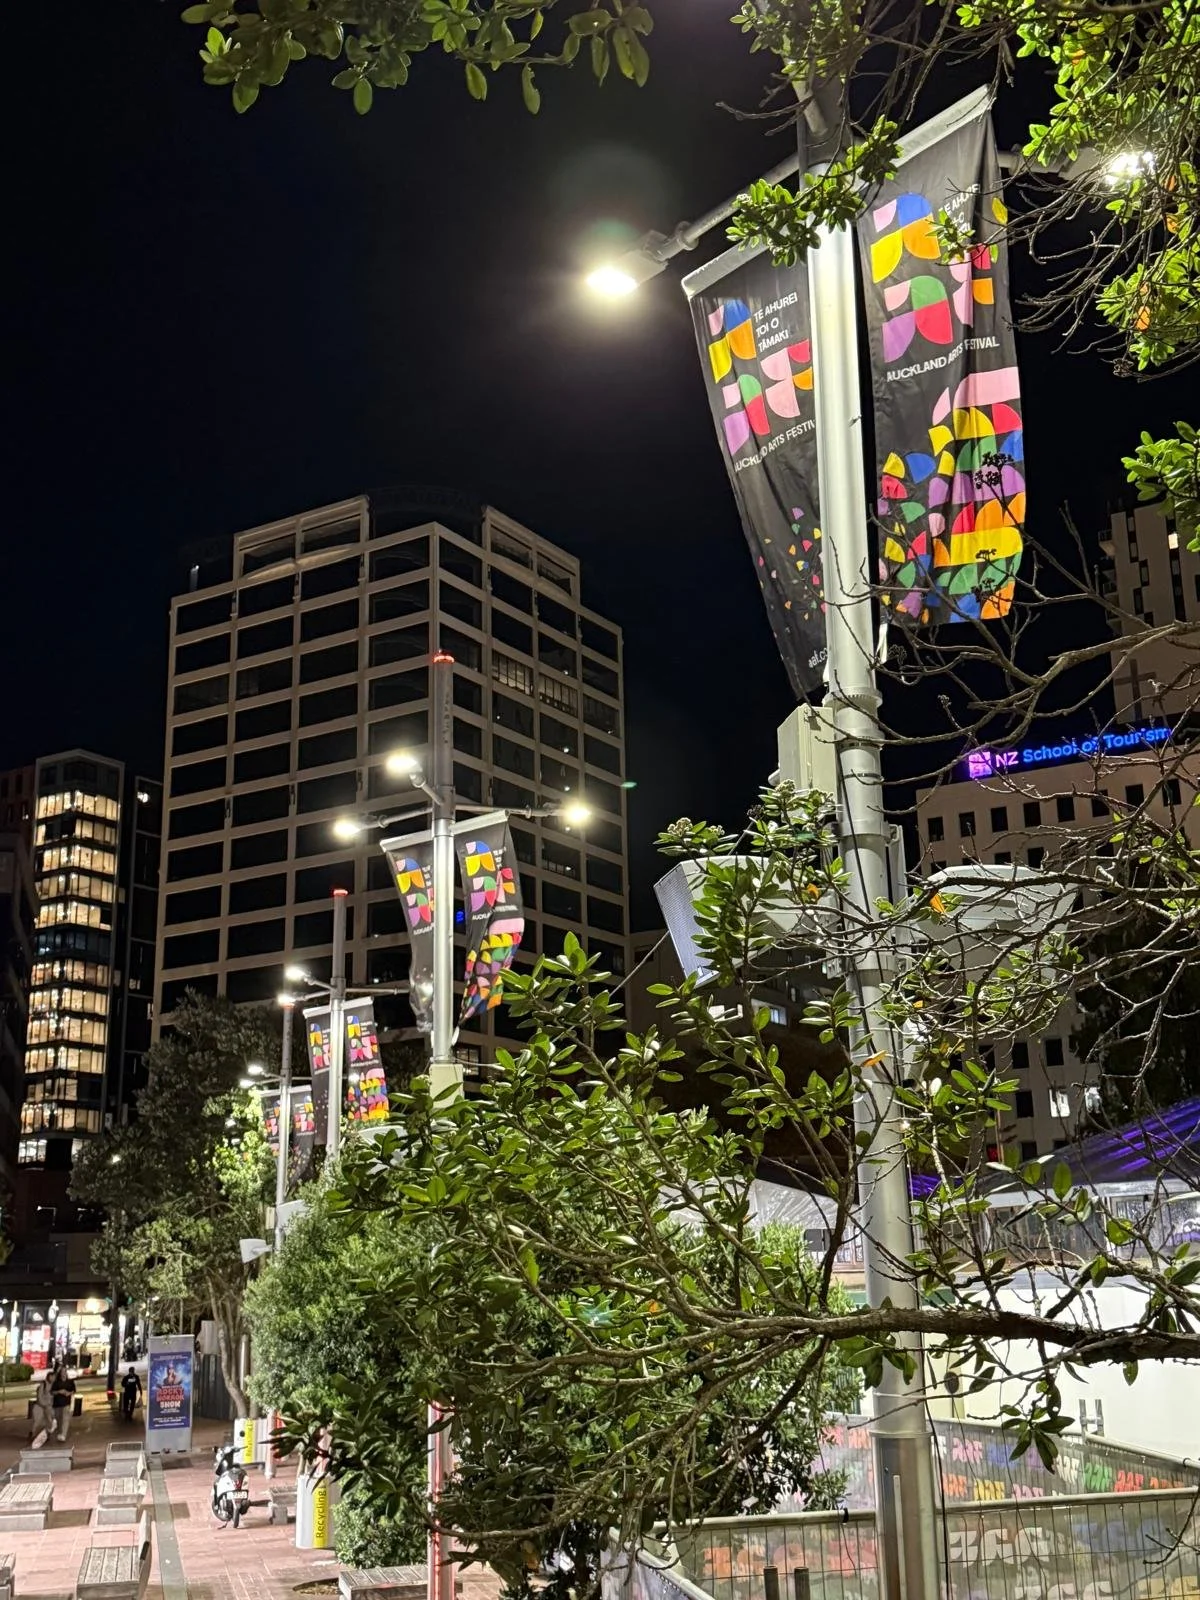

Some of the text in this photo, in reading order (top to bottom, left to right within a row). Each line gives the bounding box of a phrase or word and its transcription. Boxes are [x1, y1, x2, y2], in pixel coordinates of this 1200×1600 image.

[753, 291, 798, 323] TE AHUREI
[756, 317, 779, 338] TOI O
[886, 336, 1000, 382] AUCKLAND ARTS FSTIVAL
[768, 434, 785, 453] ARTS
[995, 751, 1019, 768] NZ
[1023, 742, 1077, 763] School
[1082, 737, 1099, 752] of
[1104, 727, 1172, 748] Tourism
[316, 1490, 327, 1538] Recycling
